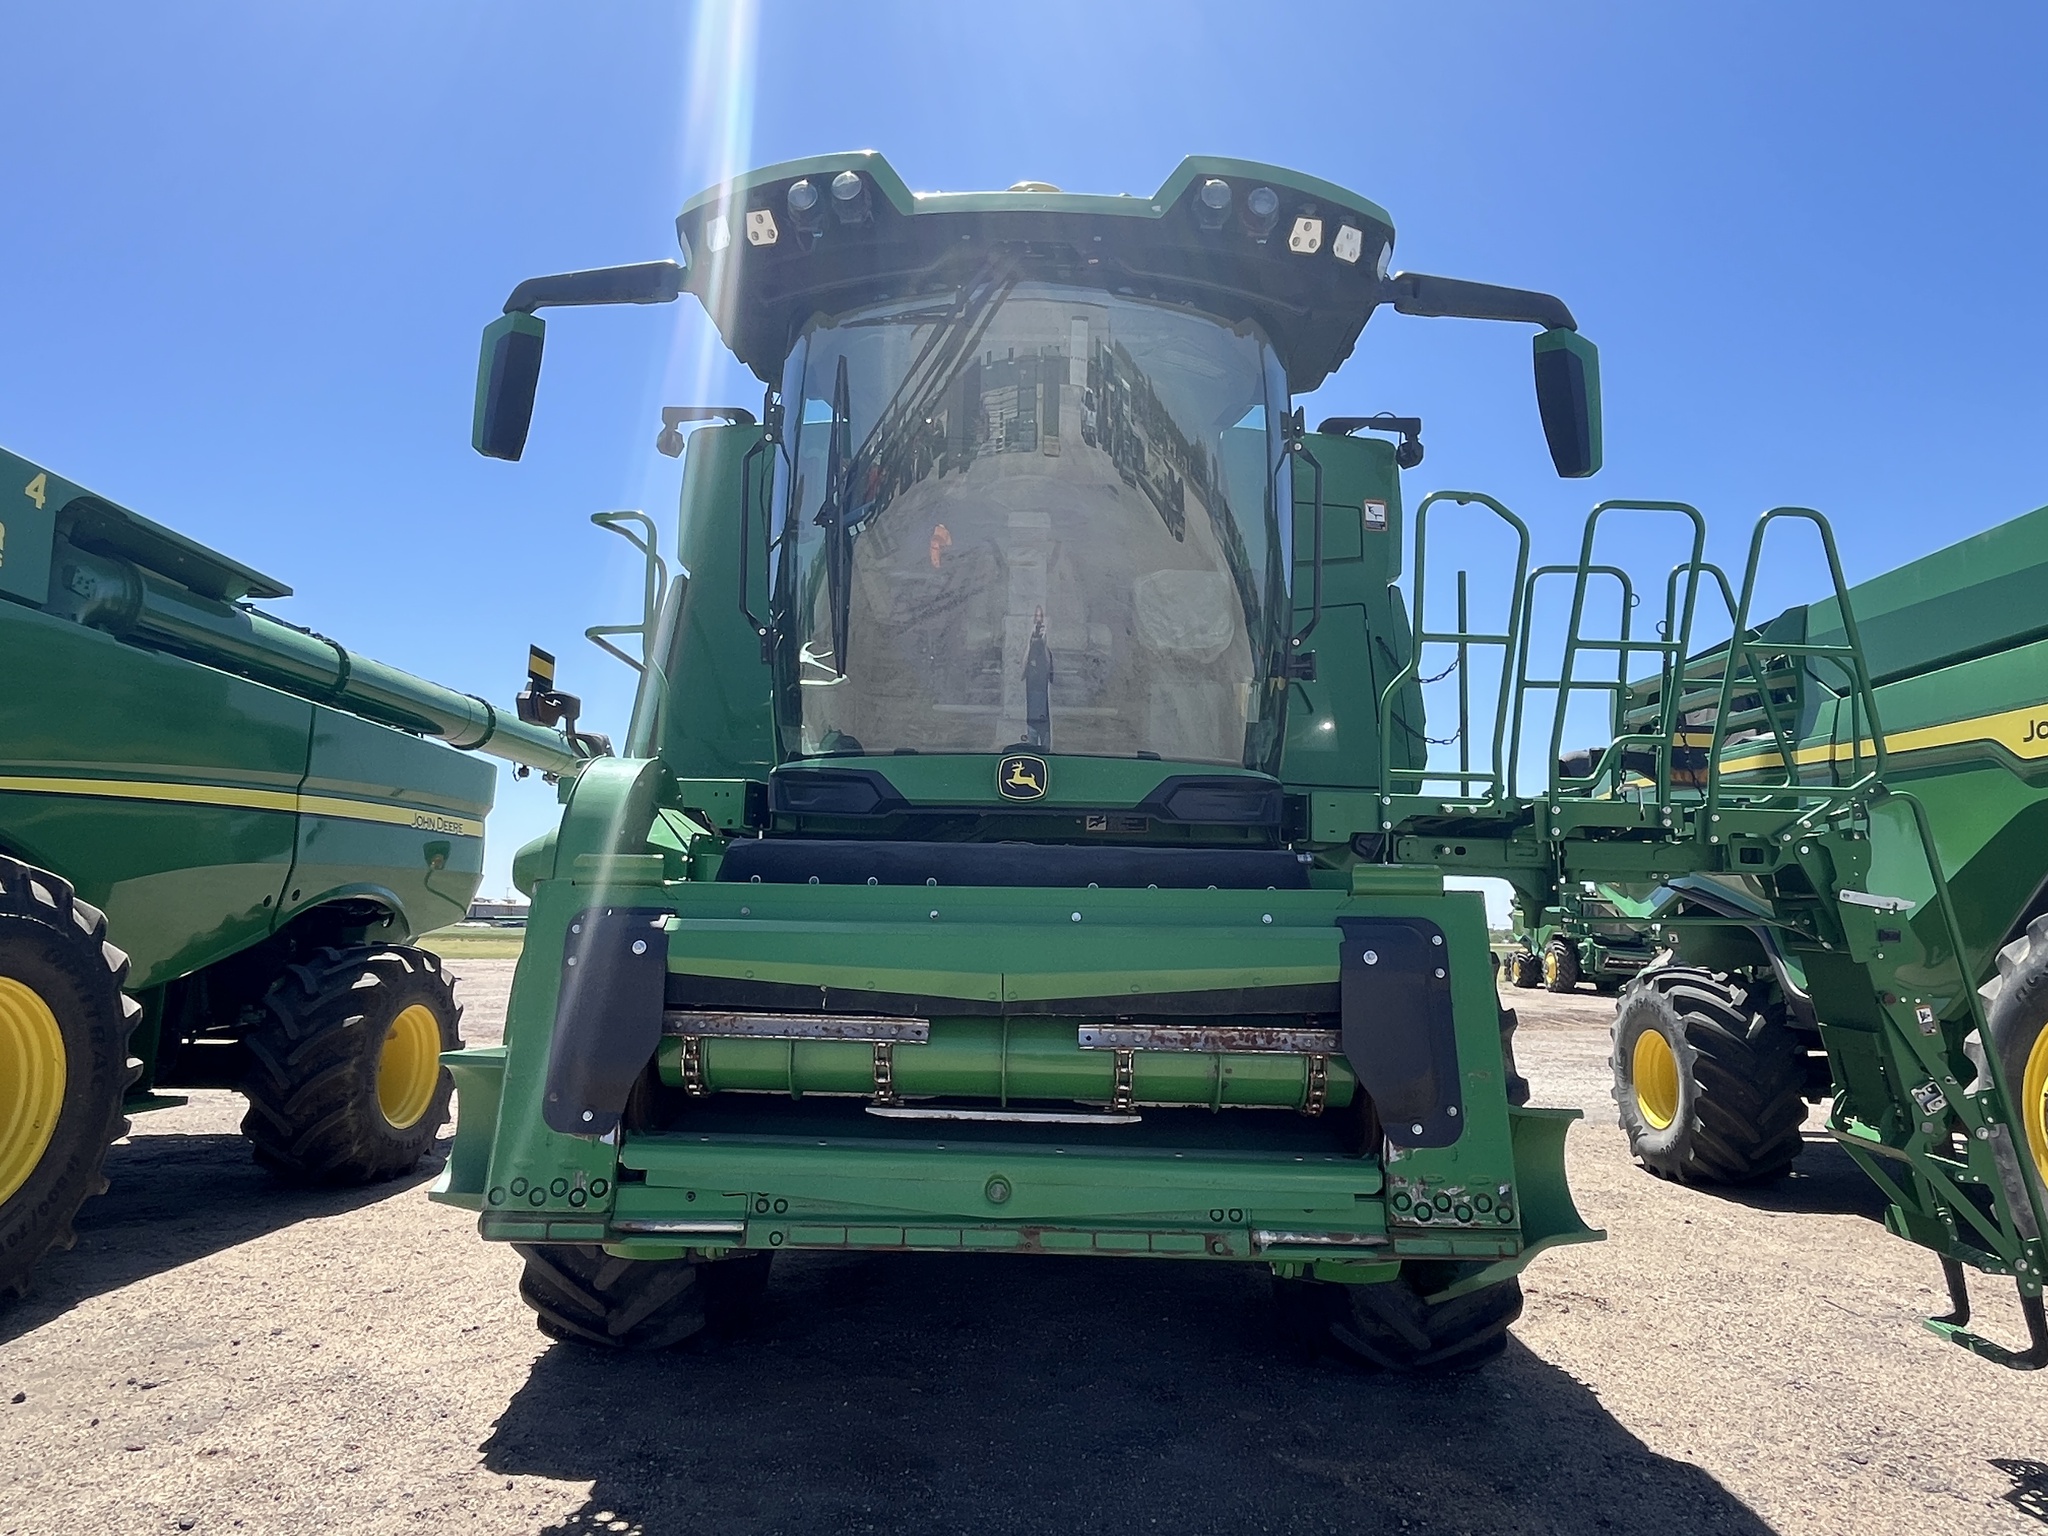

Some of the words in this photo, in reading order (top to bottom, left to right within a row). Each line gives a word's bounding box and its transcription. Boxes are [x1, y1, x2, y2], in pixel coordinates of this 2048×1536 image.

[25, 472, 47, 510] 4
[411, 812, 436, 829] JOHN
[436, 816, 464, 834] DEERE
